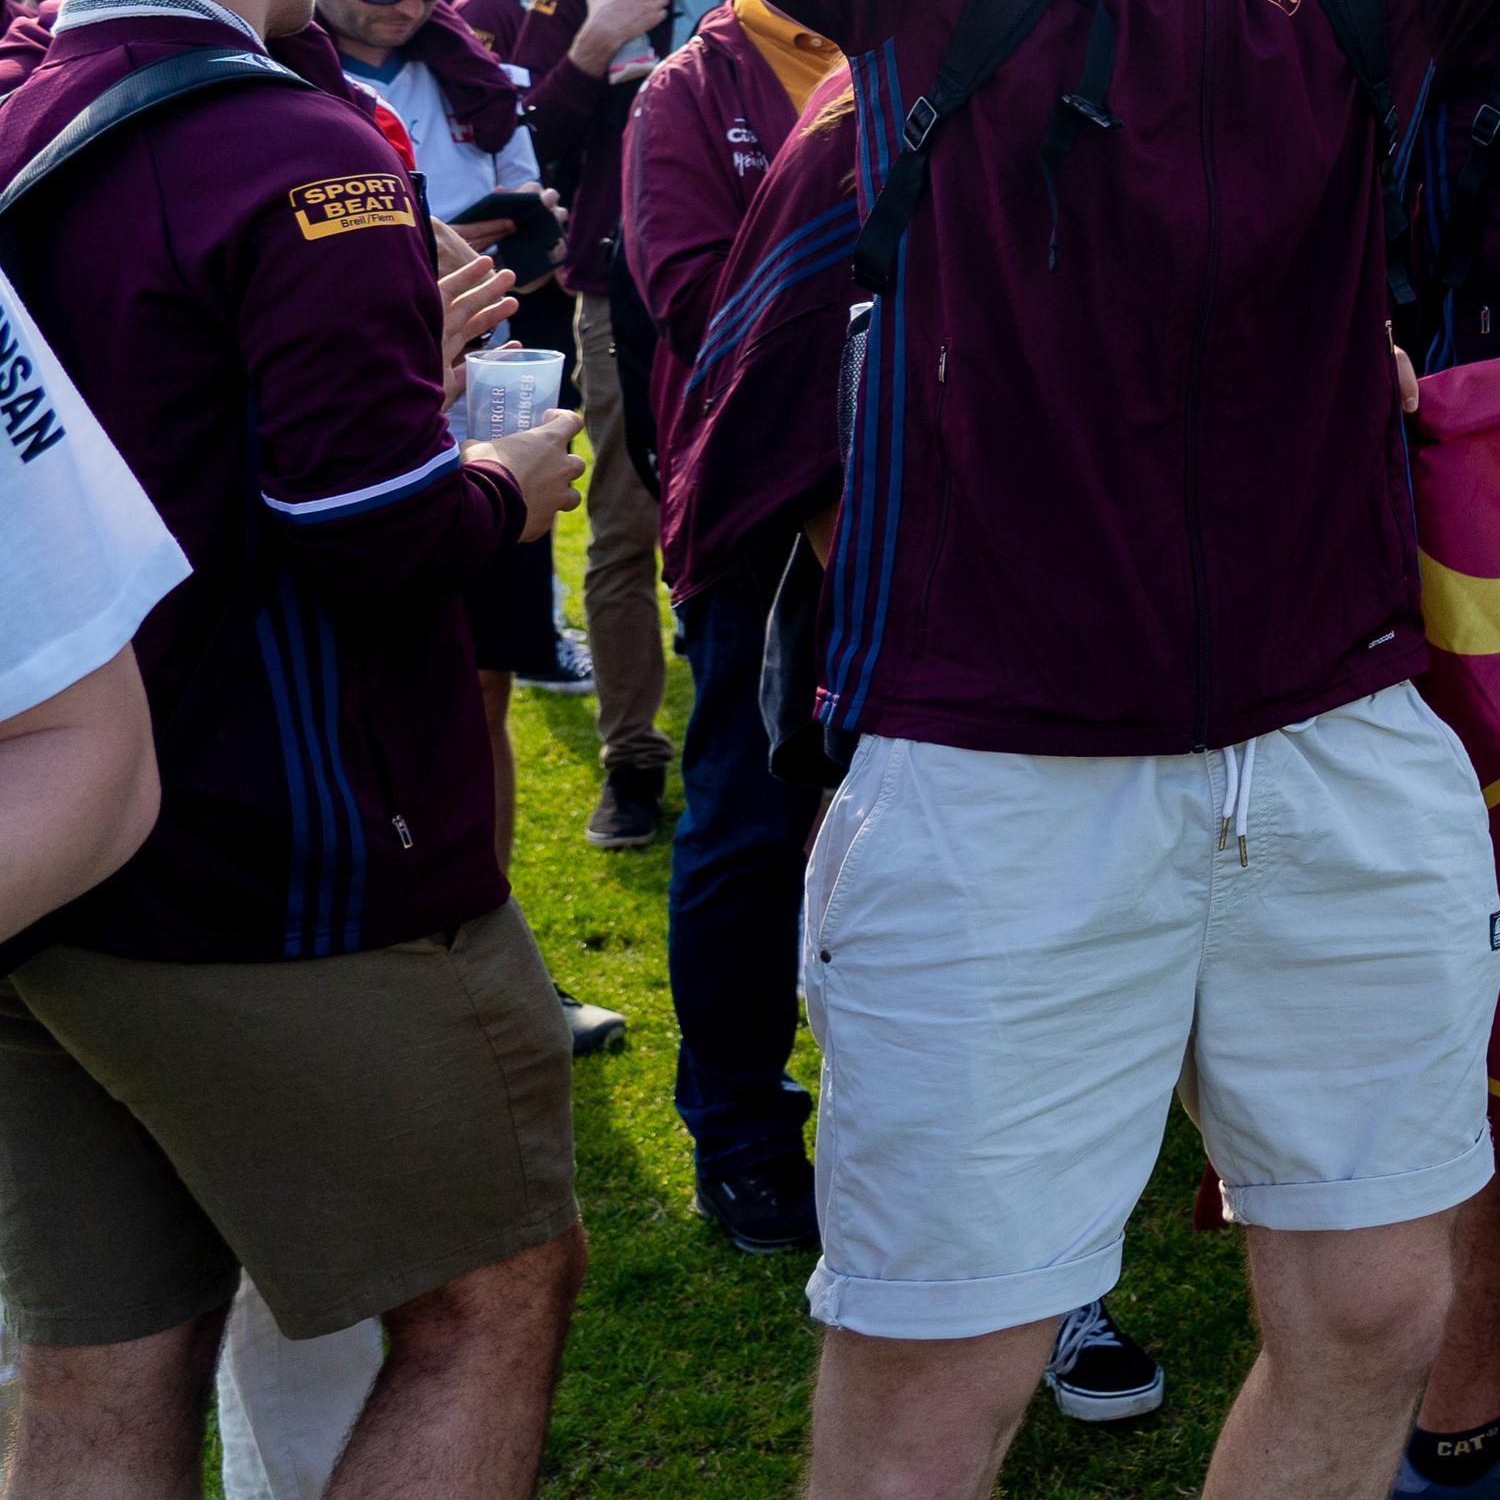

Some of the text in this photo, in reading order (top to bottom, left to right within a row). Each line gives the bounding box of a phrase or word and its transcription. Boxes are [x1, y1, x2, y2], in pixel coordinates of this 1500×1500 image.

[304, 179, 396, 205] SPORT
[323, 196, 395, 219] BEAT
[1437, 1433, 1486, 1457] CAT
